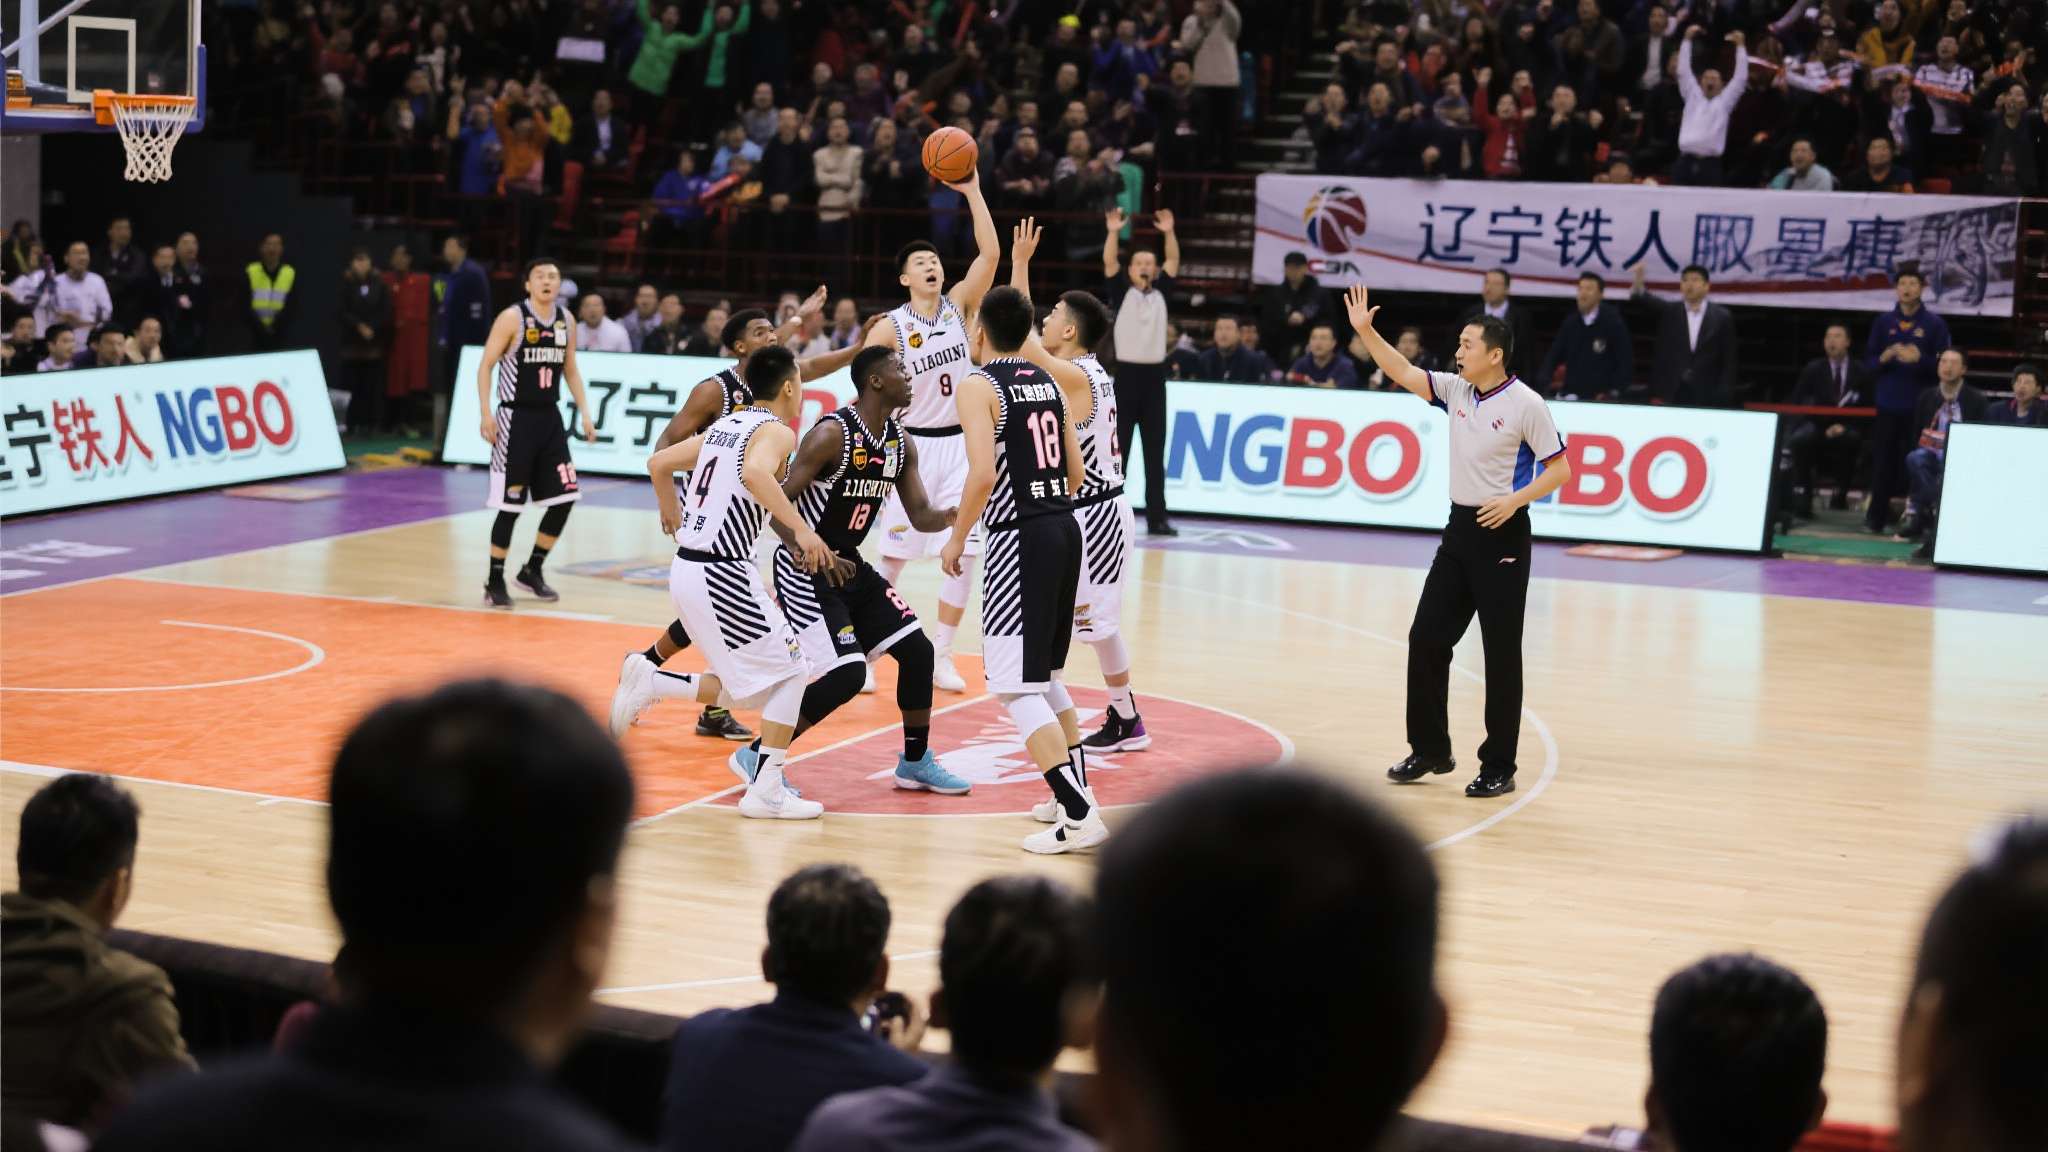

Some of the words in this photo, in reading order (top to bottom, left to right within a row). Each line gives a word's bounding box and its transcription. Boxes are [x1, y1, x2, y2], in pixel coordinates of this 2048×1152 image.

[940, 373, 952, 397] 8
[0, 394, 155, 480] 宁铁人
[155, 380, 294, 459] NGBO
[1026, 409, 1061, 470] 18
[1166, 410, 1421, 495] NGBO
[695, 456, 718, 509] 4
[1535, 432, 1708, 513] BO
